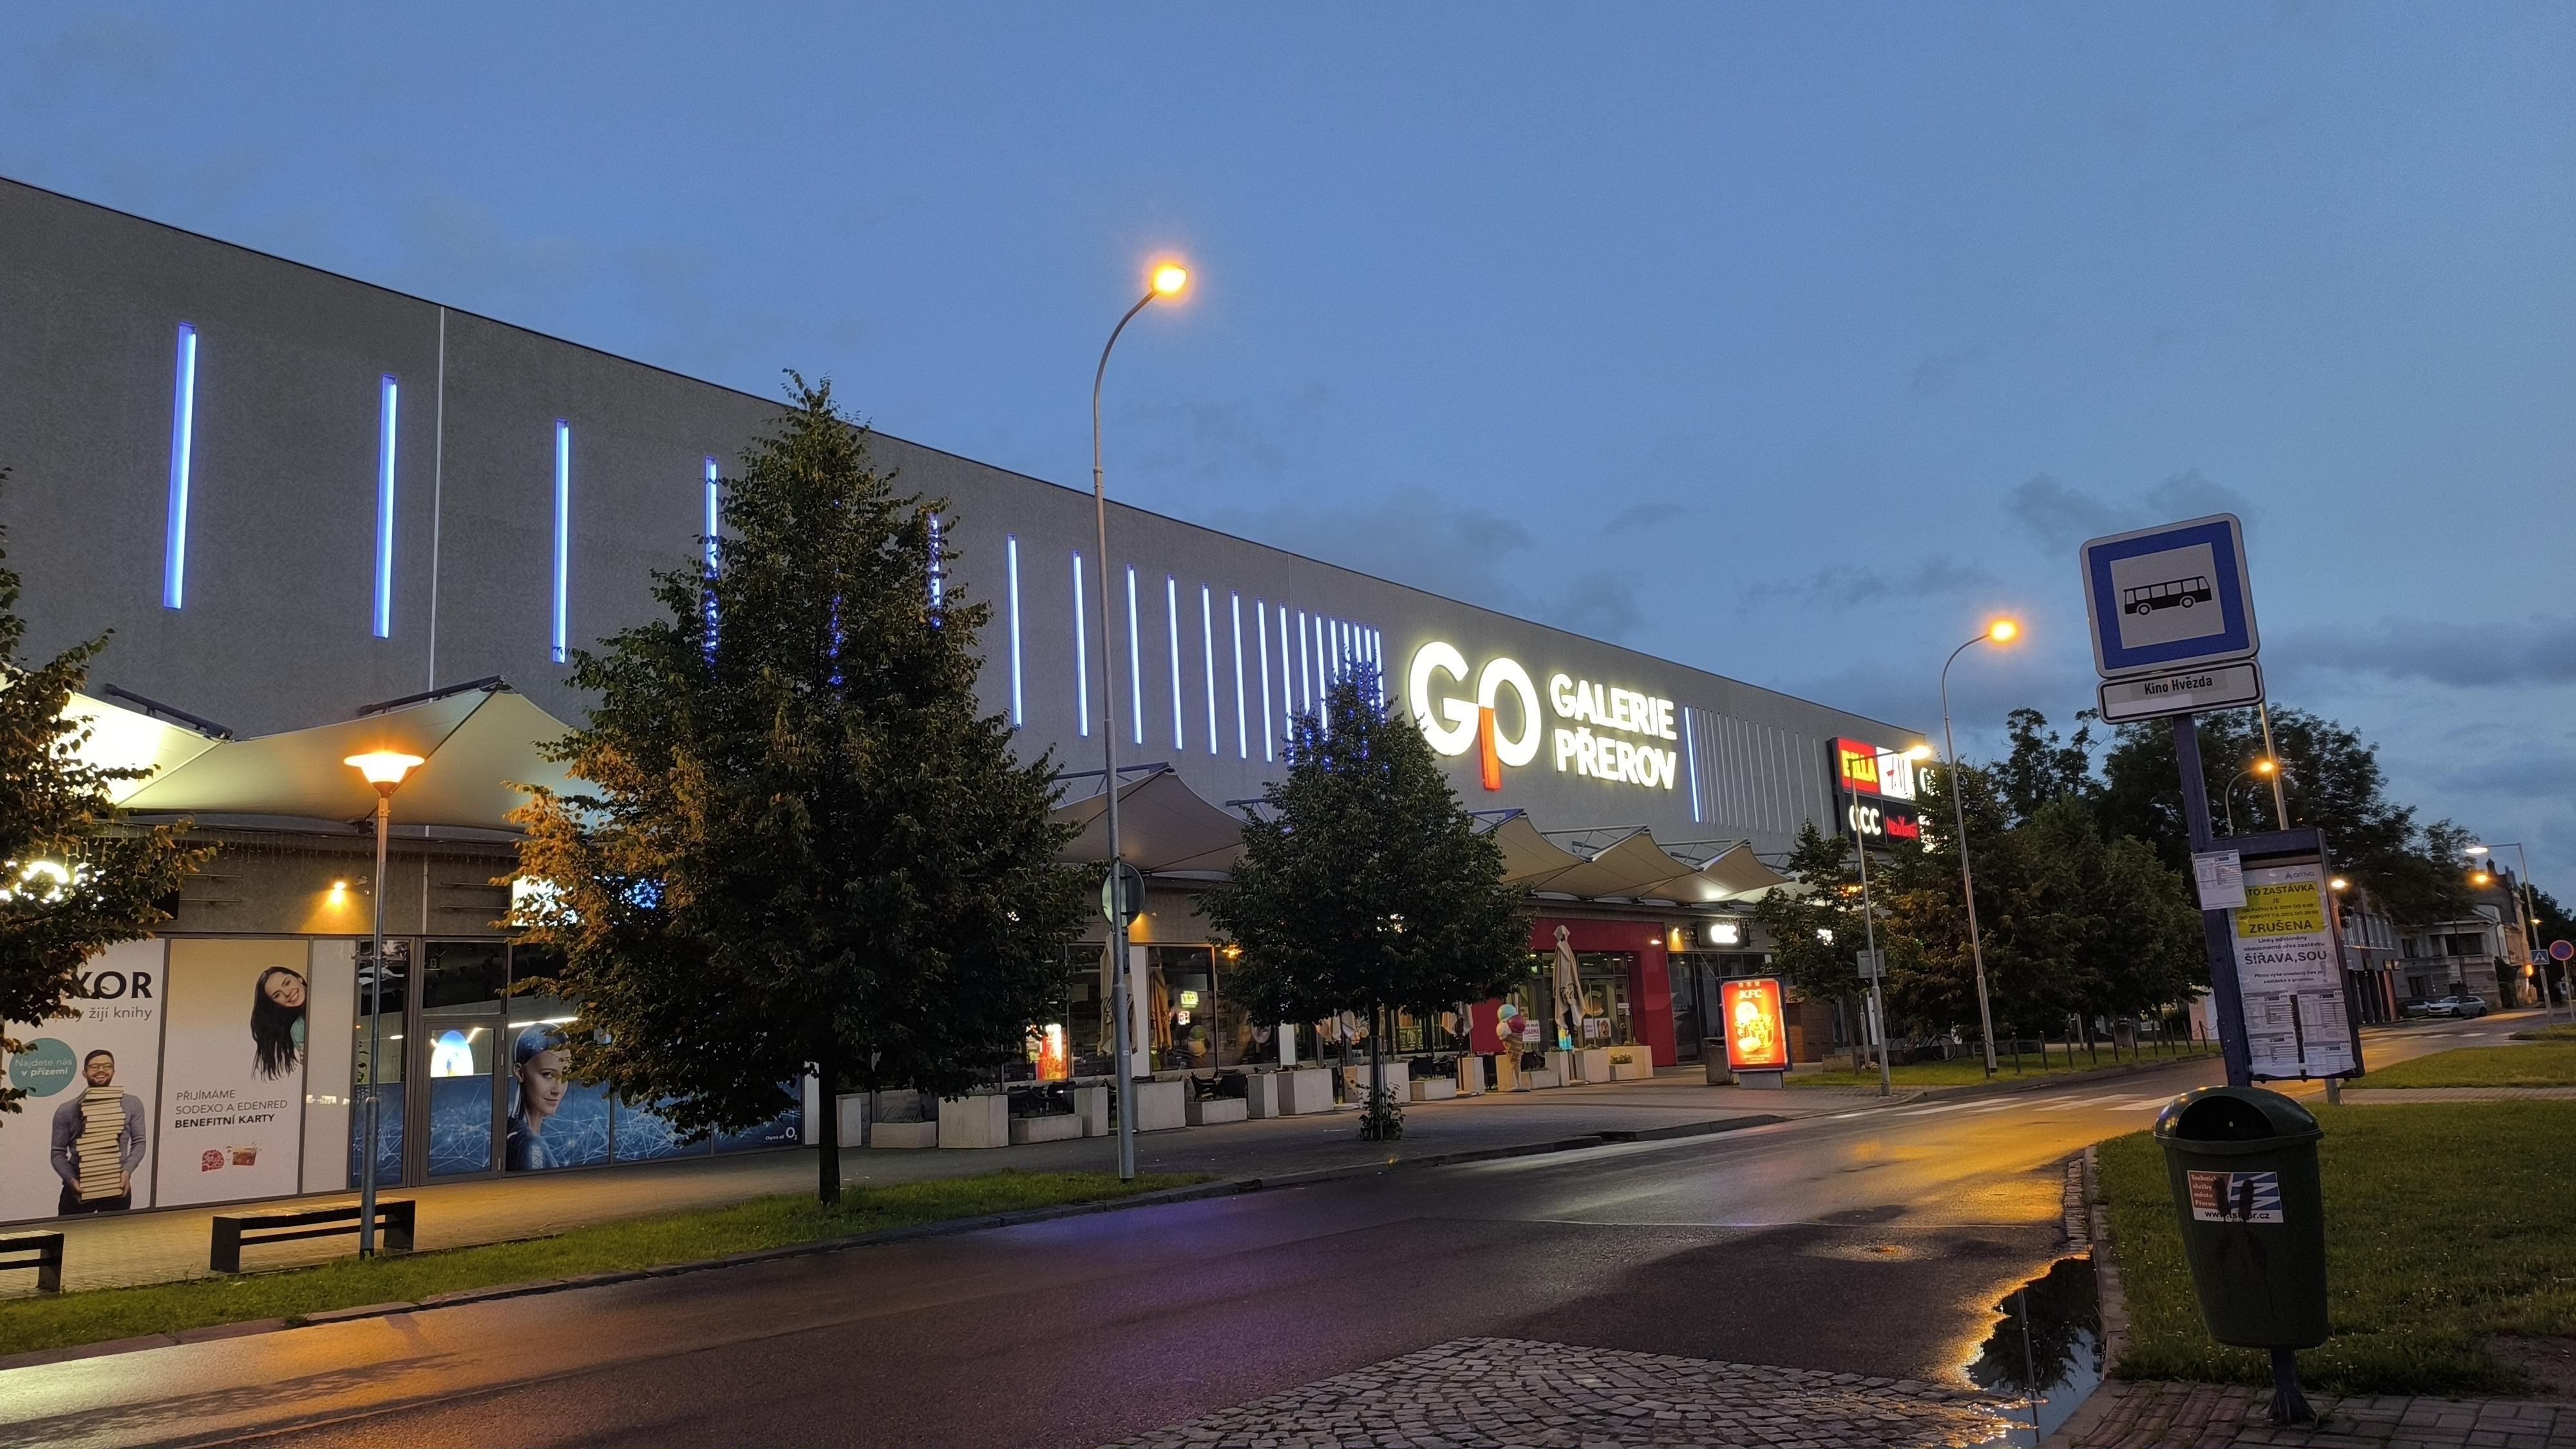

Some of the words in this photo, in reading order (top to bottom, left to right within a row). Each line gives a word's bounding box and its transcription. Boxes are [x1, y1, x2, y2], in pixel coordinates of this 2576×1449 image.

[2145, 682, 2169, 695] Kino
[2172, 676, 2213, 691] Hvězda
[1549, 673, 1677, 740] GALERIE
[1554, 726, 1677, 790] PŘEROV
[1841, 750, 1878, 783] BILLA
[1849, 805, 1881, 835] CCC
[2263, 883, 2315, 895] ZASTÁVKA
[2249, 920, 2313, 933] ZRUŠENA
[1739, 989, 1763, 999] KFC
[89, 1007, 109, 1022] žijí
[113, 1006, 153, 1021] knihy
[15, 1059, 54, 1068] Najdete
[56, 1057, 73, 1066] nás
[30, 1066, 69, 1078] přízemí
[176, 1088, 237, 1101] PŘIJÍMÁME
[175, 1103, 223, 1115] SODEXO
[226, 1103, 235, 1112] A
[238, 1099, 288, 1112] EDENRED
[175, 1114, 235, 1128] BENEFITNÍ
[239, 1113, 275, 1124] KARTY
